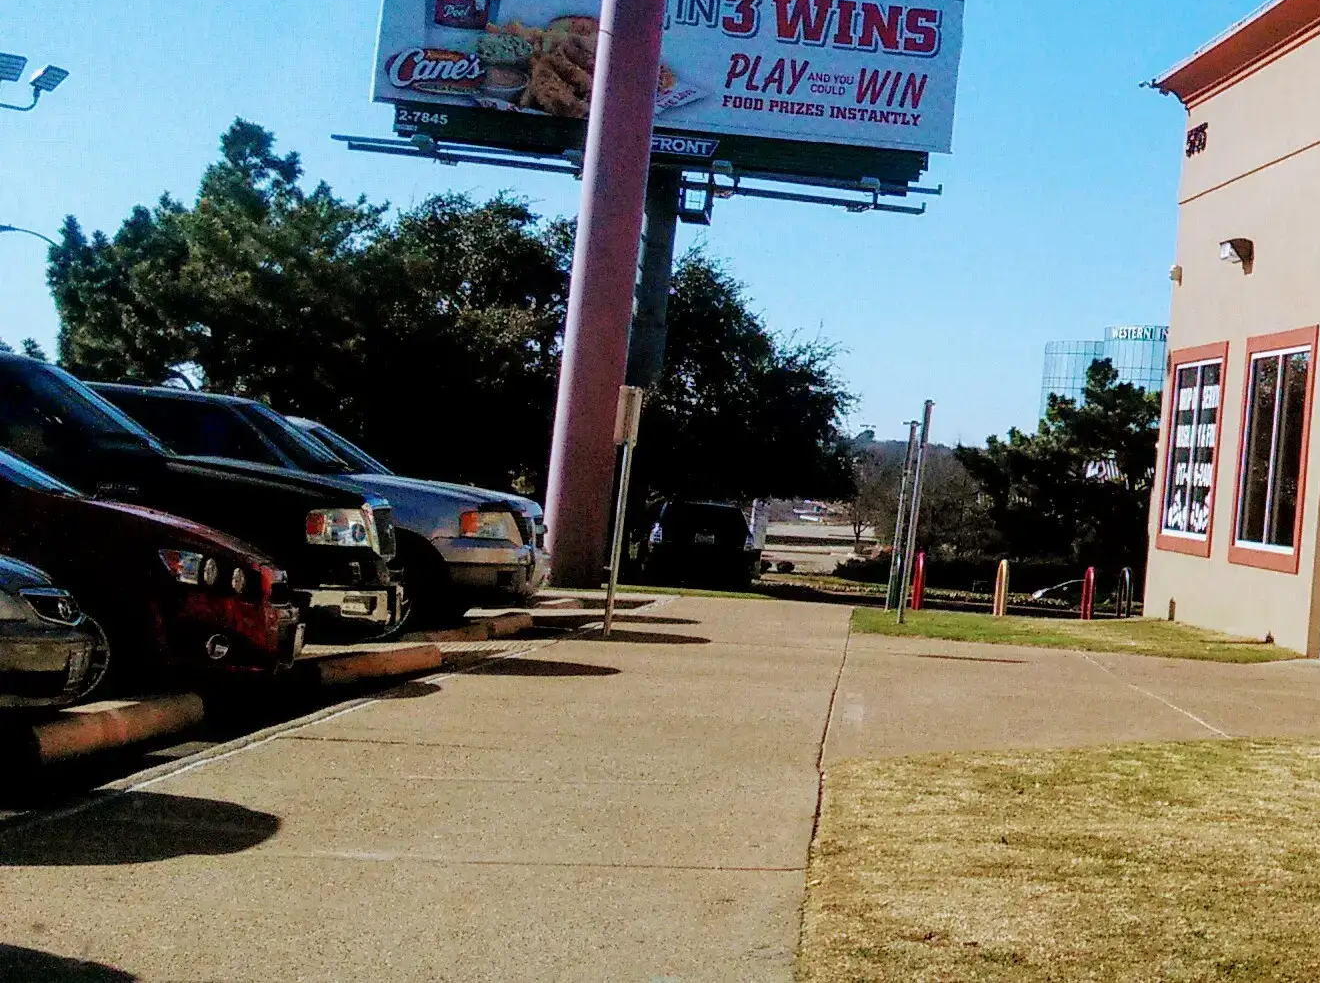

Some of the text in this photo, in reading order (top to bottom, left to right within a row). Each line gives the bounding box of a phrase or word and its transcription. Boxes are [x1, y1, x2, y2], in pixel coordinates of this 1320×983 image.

[389, 47, 485, 87] Cane's
[725, 53, 928, 109] PLAY AND YOU WIN
[810, 84, 845, 96] COULD
[722, 95, 921, 126] FOOD PRIZES INSTANTLY
[1112, 327, 1153, 340] WESTERN
